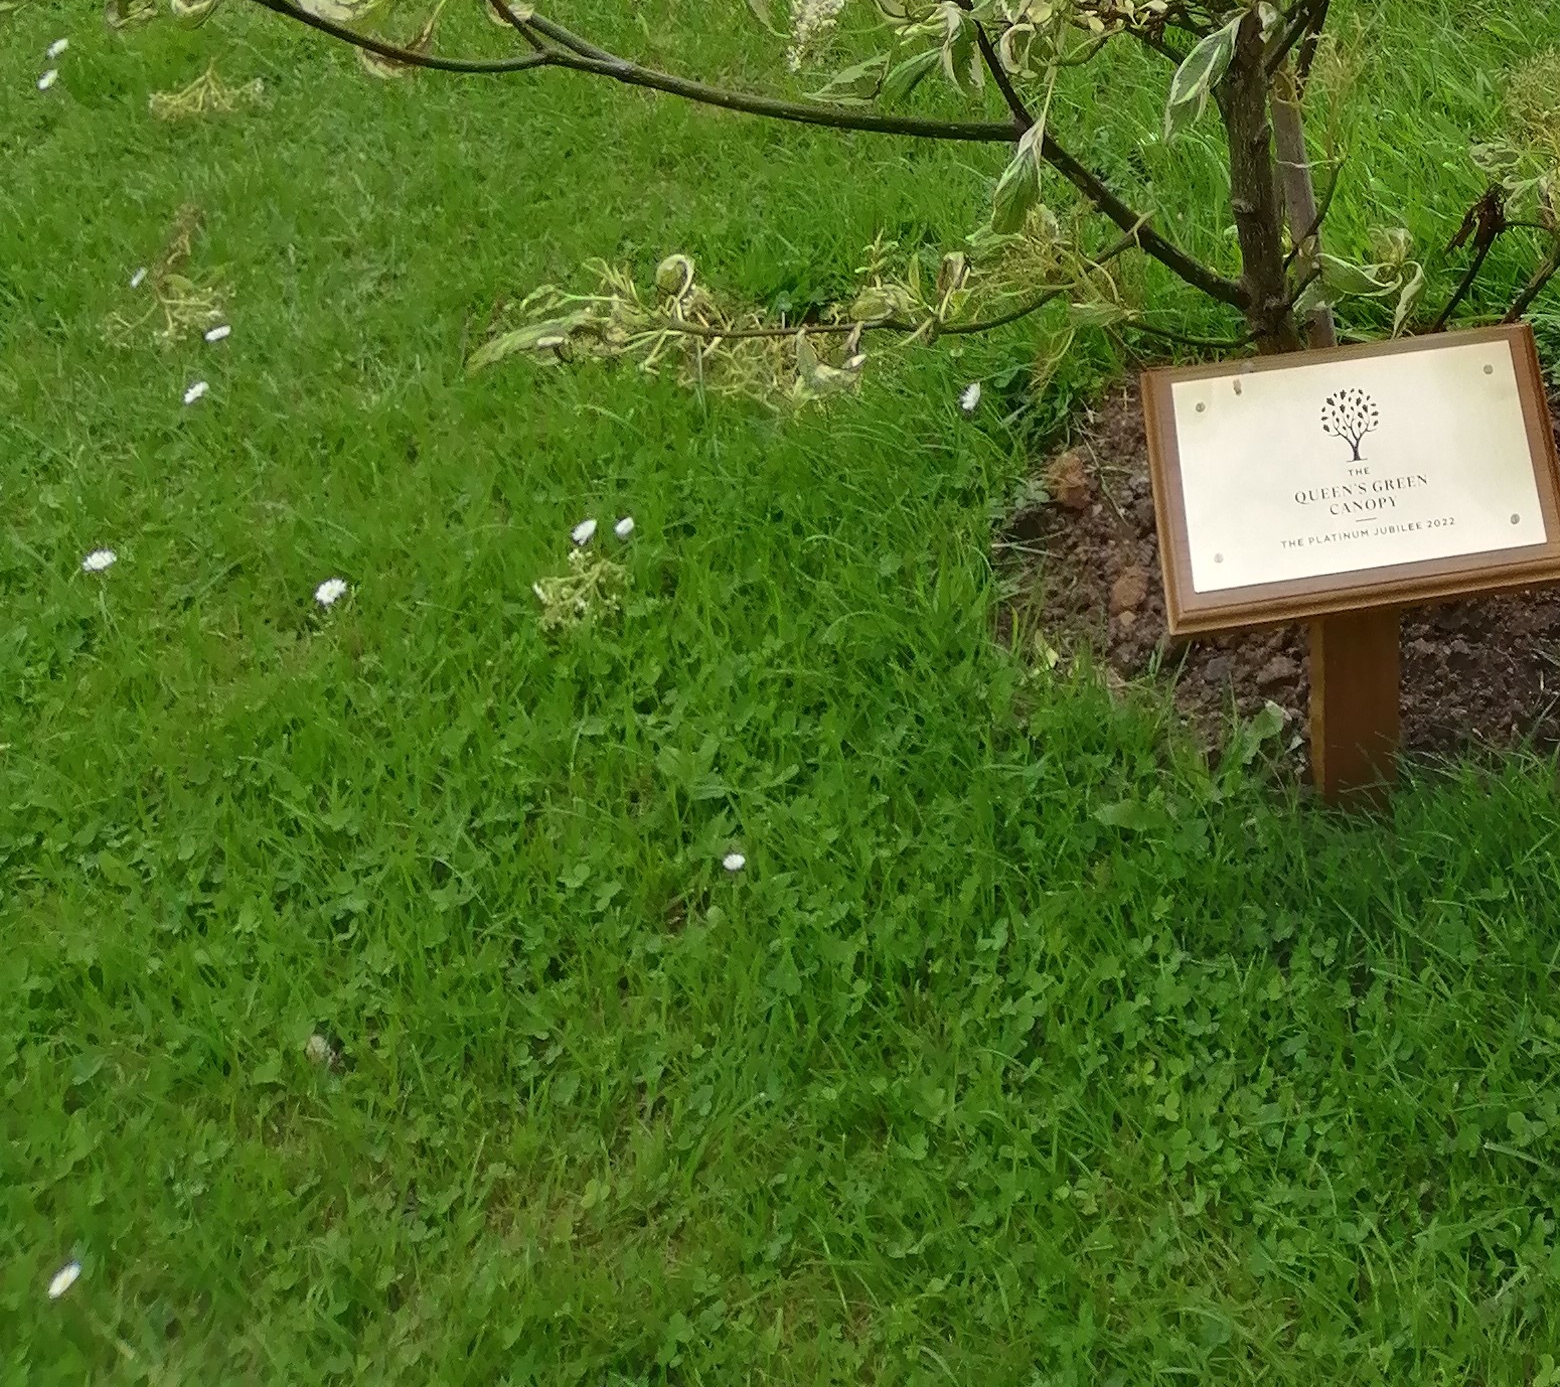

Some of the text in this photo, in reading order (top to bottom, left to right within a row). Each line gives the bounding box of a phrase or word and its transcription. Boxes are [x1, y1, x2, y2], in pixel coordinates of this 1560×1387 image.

[1348, 467, 1371, 477] THE
[1294, 474, 1429, 505] QUEEN'S GREEN
[1329, 496, 1398, 516] CANOPY
[1281, 517, 1456, 549] THE PLATINUM JUBILEE 2022
